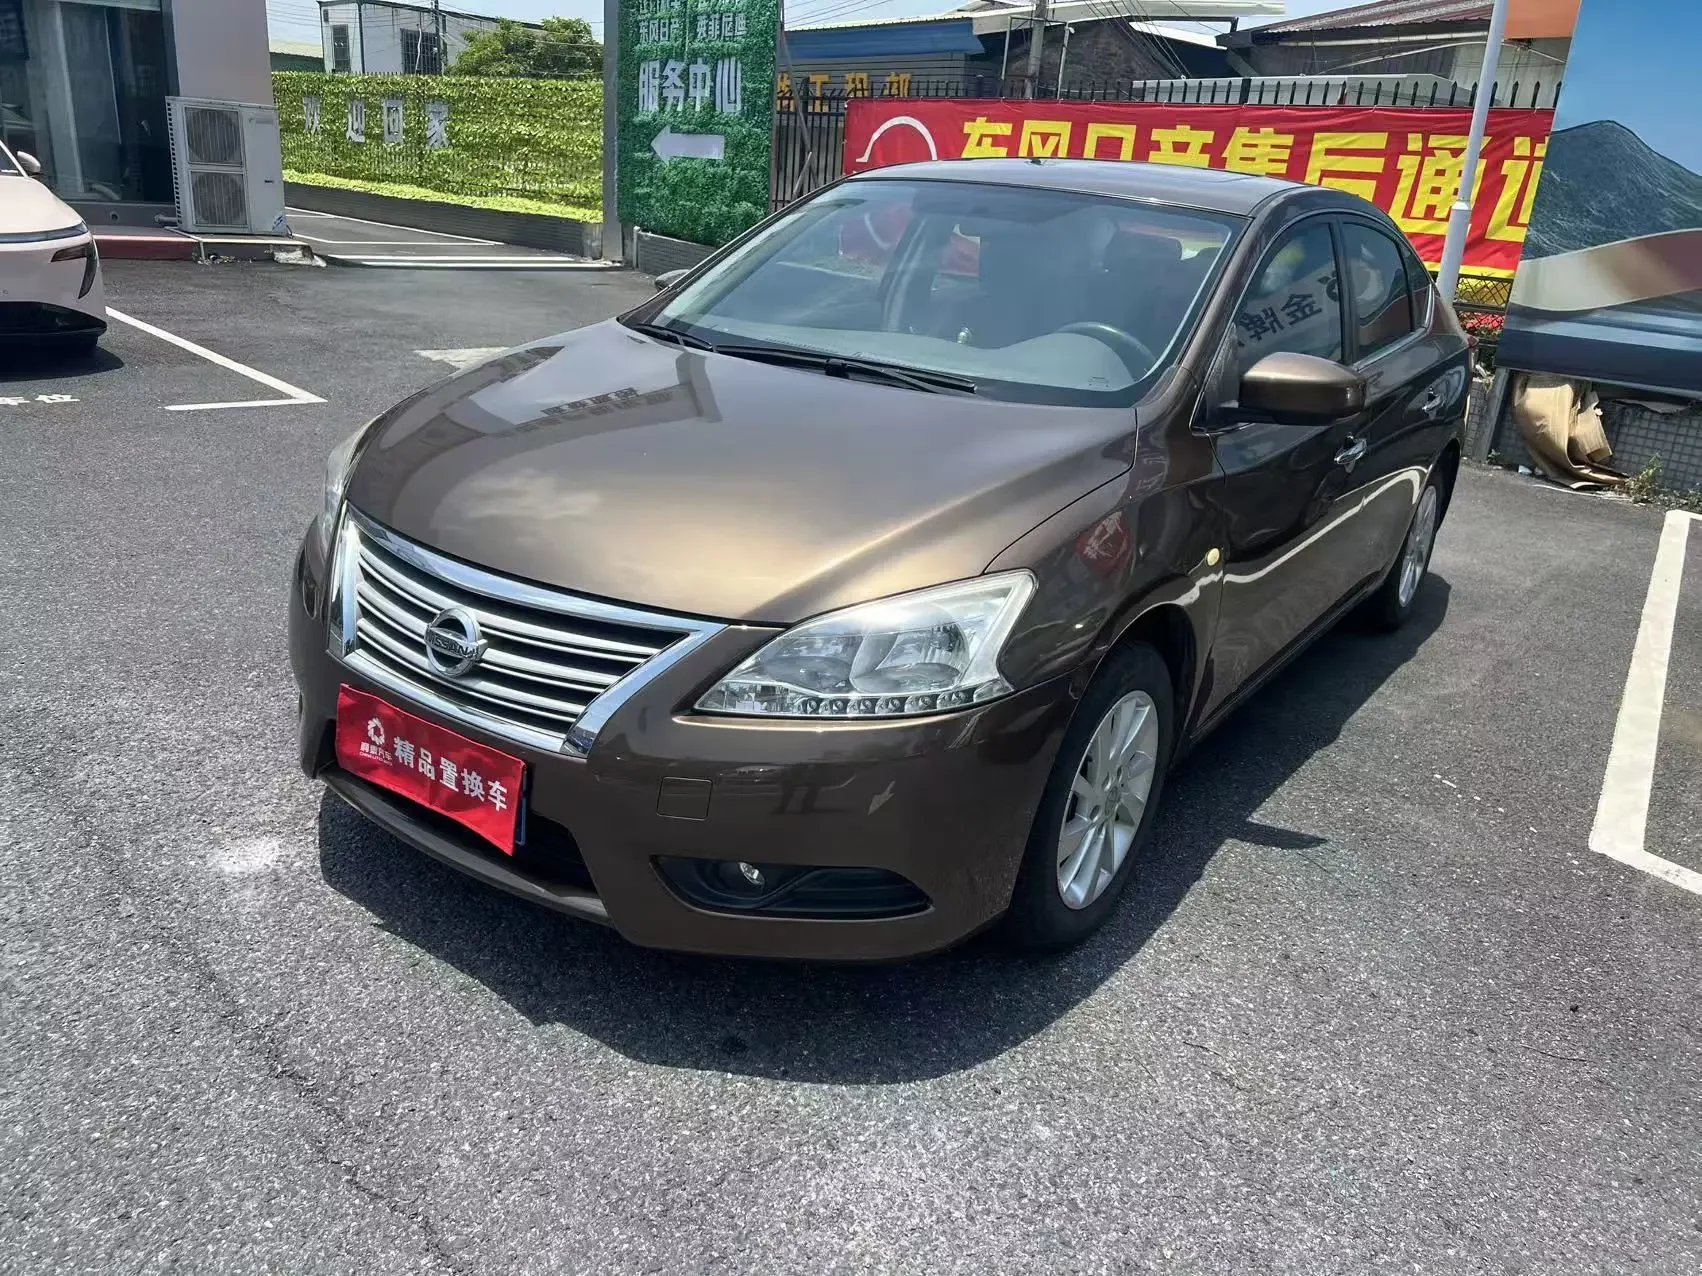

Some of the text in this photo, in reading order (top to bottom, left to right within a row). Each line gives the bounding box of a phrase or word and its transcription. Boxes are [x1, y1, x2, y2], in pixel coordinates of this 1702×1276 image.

[638, 57, 742, 113] 服务中心
[426, 633, 471, 656] NISSAN
[393, 736, 508, 812] 精品置换车
